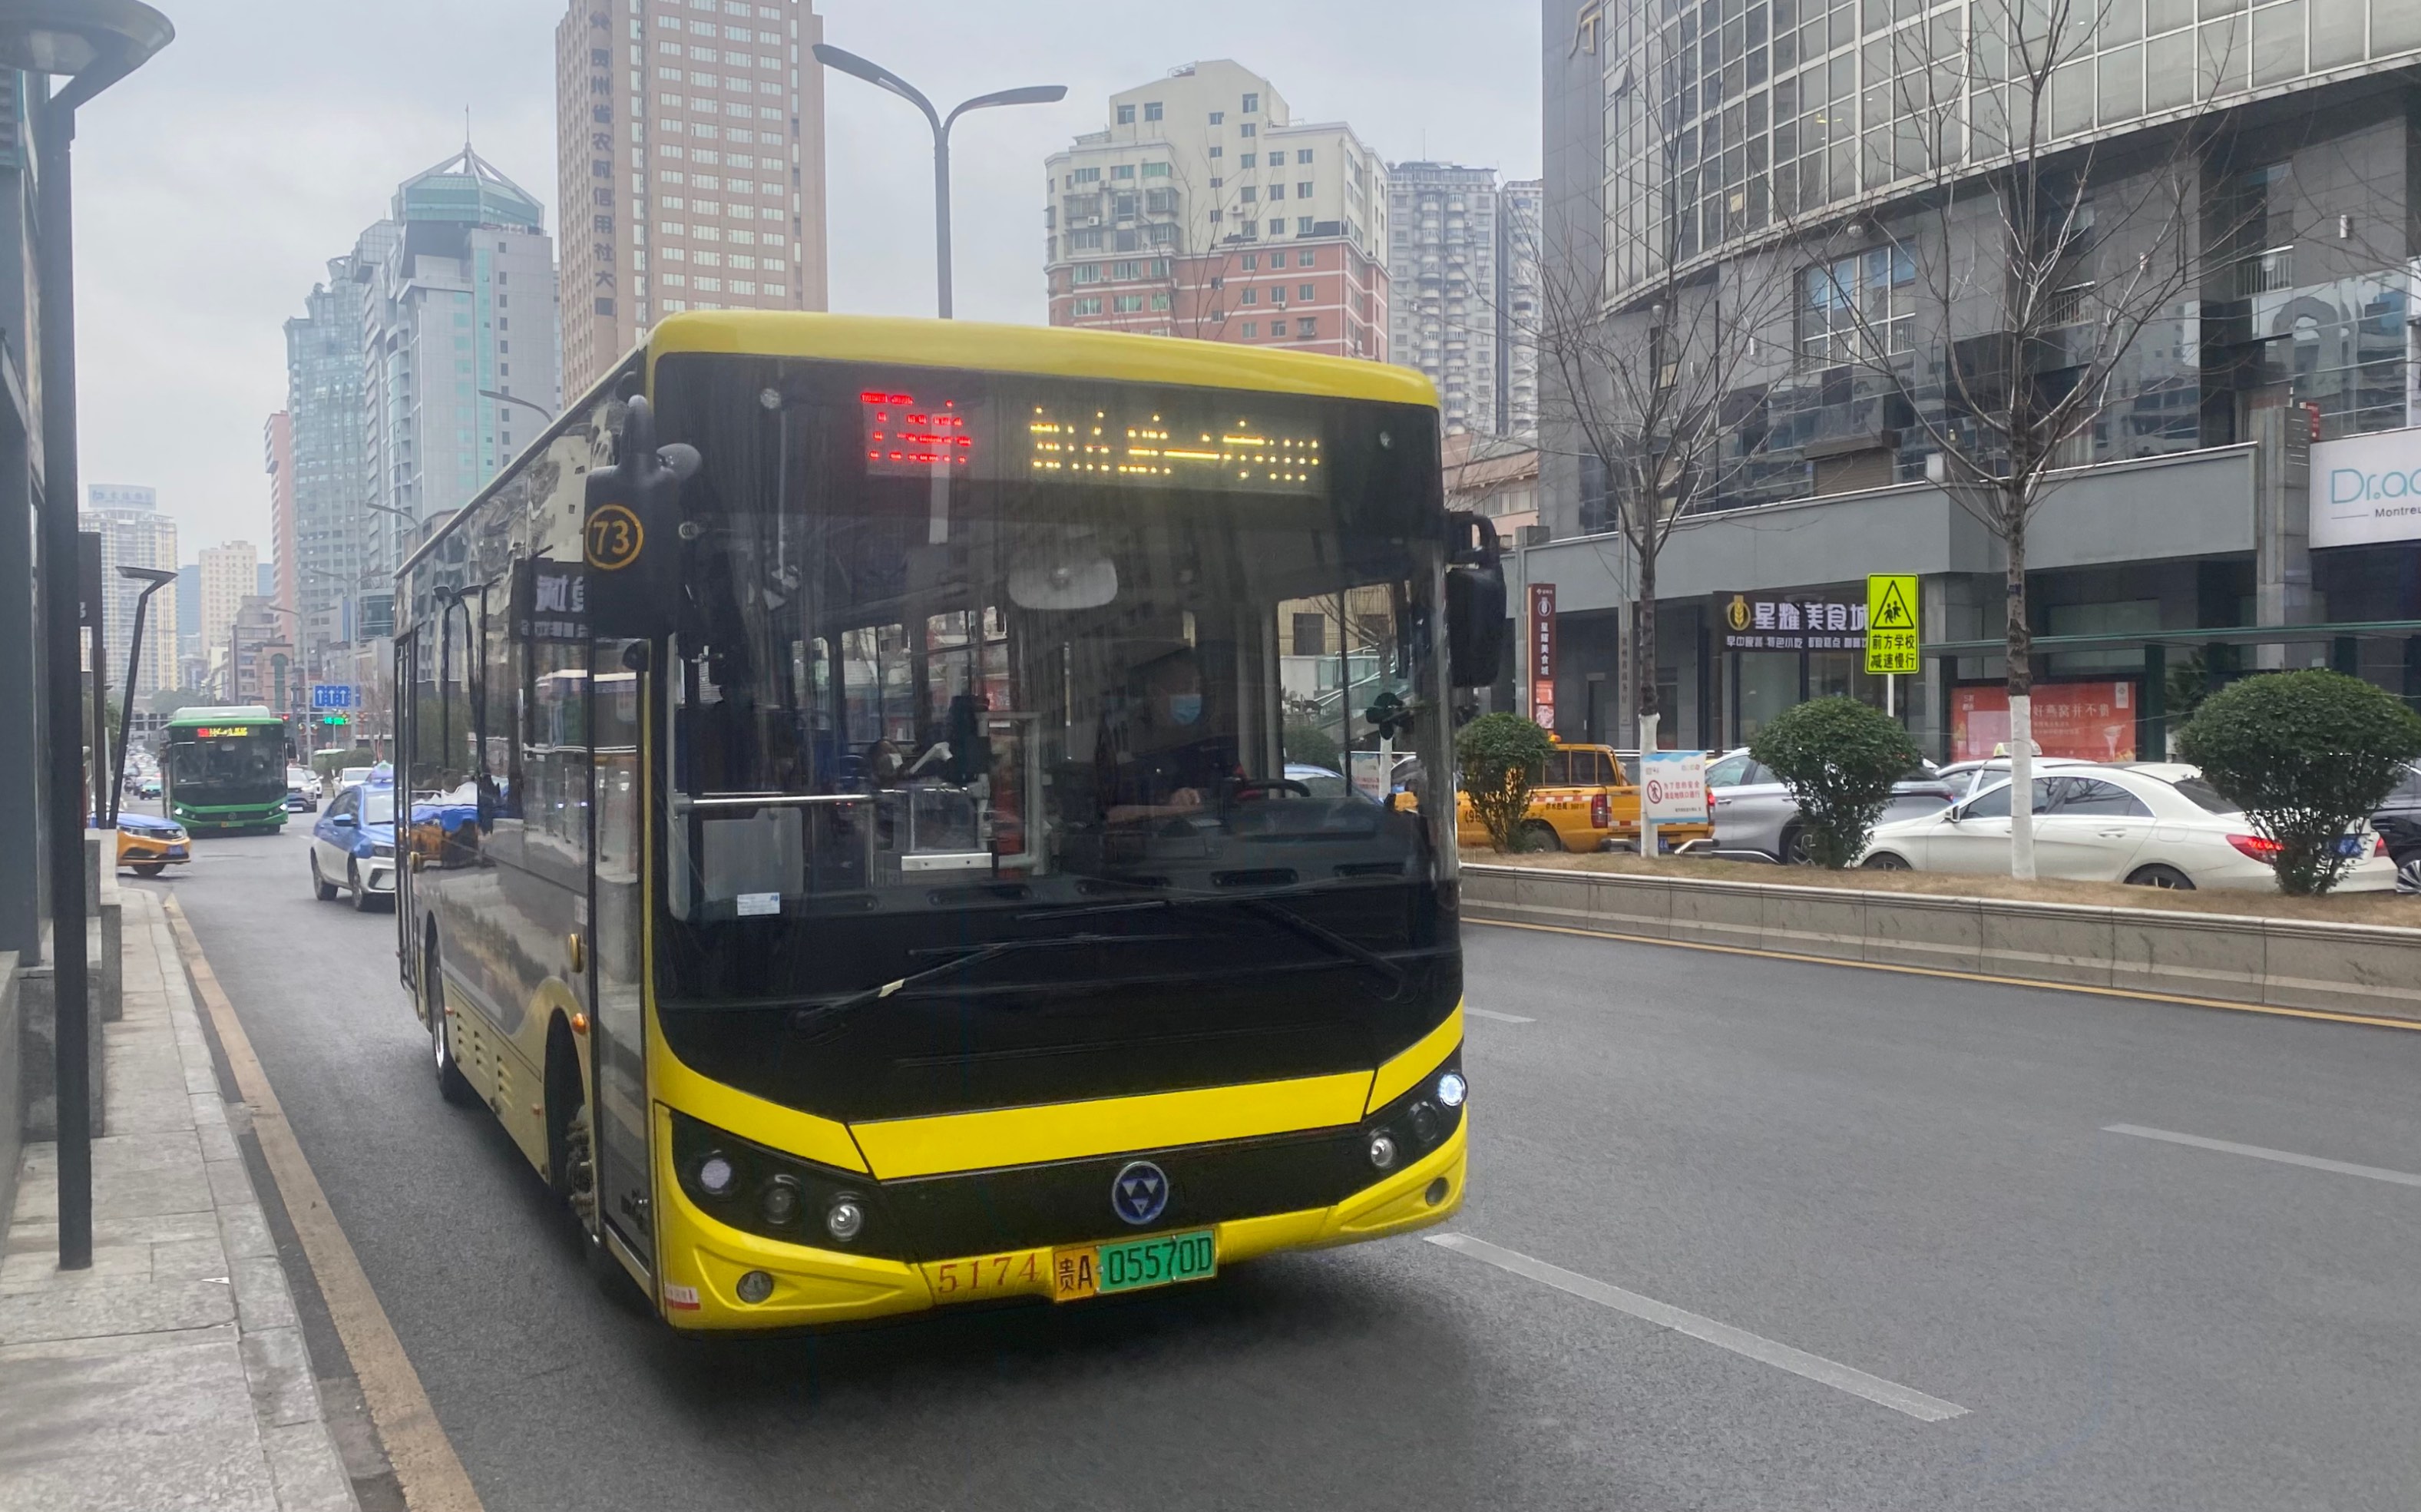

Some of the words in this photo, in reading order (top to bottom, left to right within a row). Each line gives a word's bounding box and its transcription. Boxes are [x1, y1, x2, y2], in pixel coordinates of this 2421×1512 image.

[594, 520, 630, 555] 73
[1755, 601, 1867, 632] 星耀美食城
[1872, 634, 1915, 650] 前方学校
[1870, 653, 1915, 669] 减速慢行
[938, 1252, 1040, 1293] 5174
[1109, 1236, 1212, 1285] 05570D
